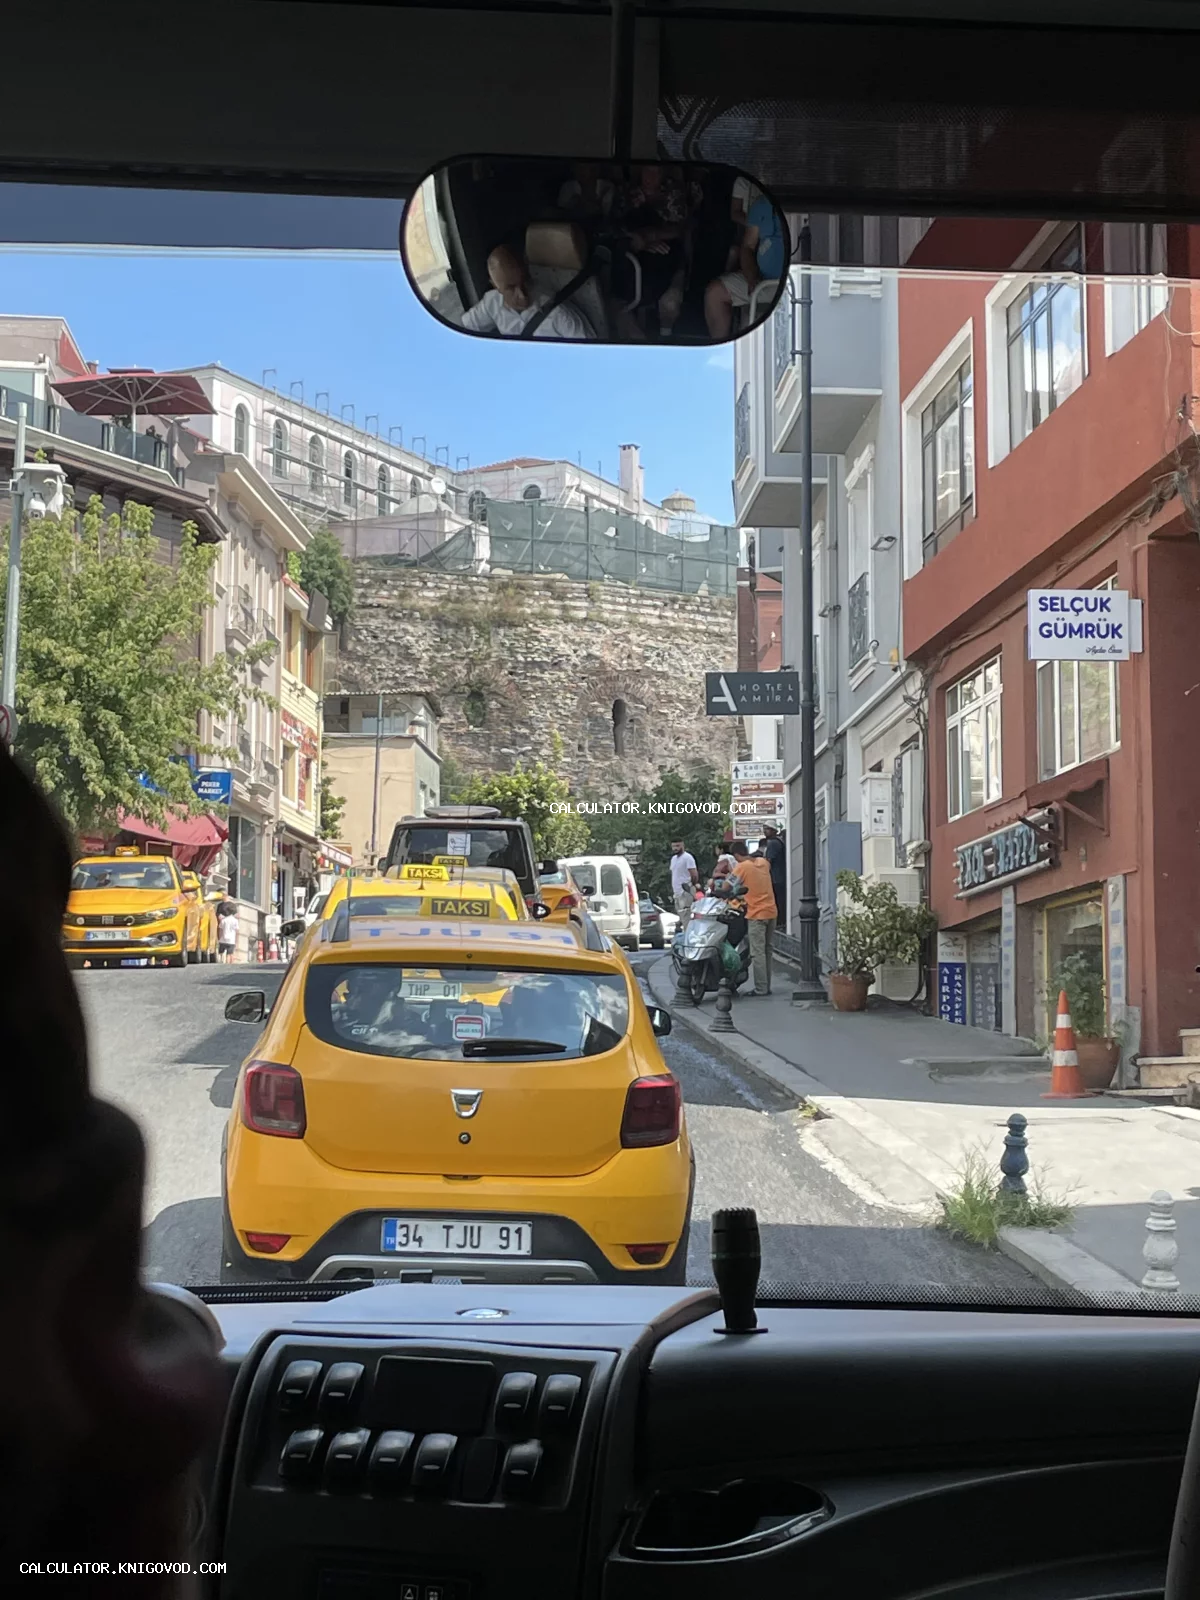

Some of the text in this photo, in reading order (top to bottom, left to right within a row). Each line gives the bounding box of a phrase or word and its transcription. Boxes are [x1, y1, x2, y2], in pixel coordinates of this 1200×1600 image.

[1038, 596, 1111, 617] SELÇUK
[1038, 617, 1123, 639] GÜMRÜK
[739, 683, 794, 692] HOTEL
[740, 695, 794, 703] AMIRA
[408, 983, 456, 997] THP 01
[941, 966, 951, 1021] AIRPOR
[398, 1224, 523, 1251] 34 TJU 91
